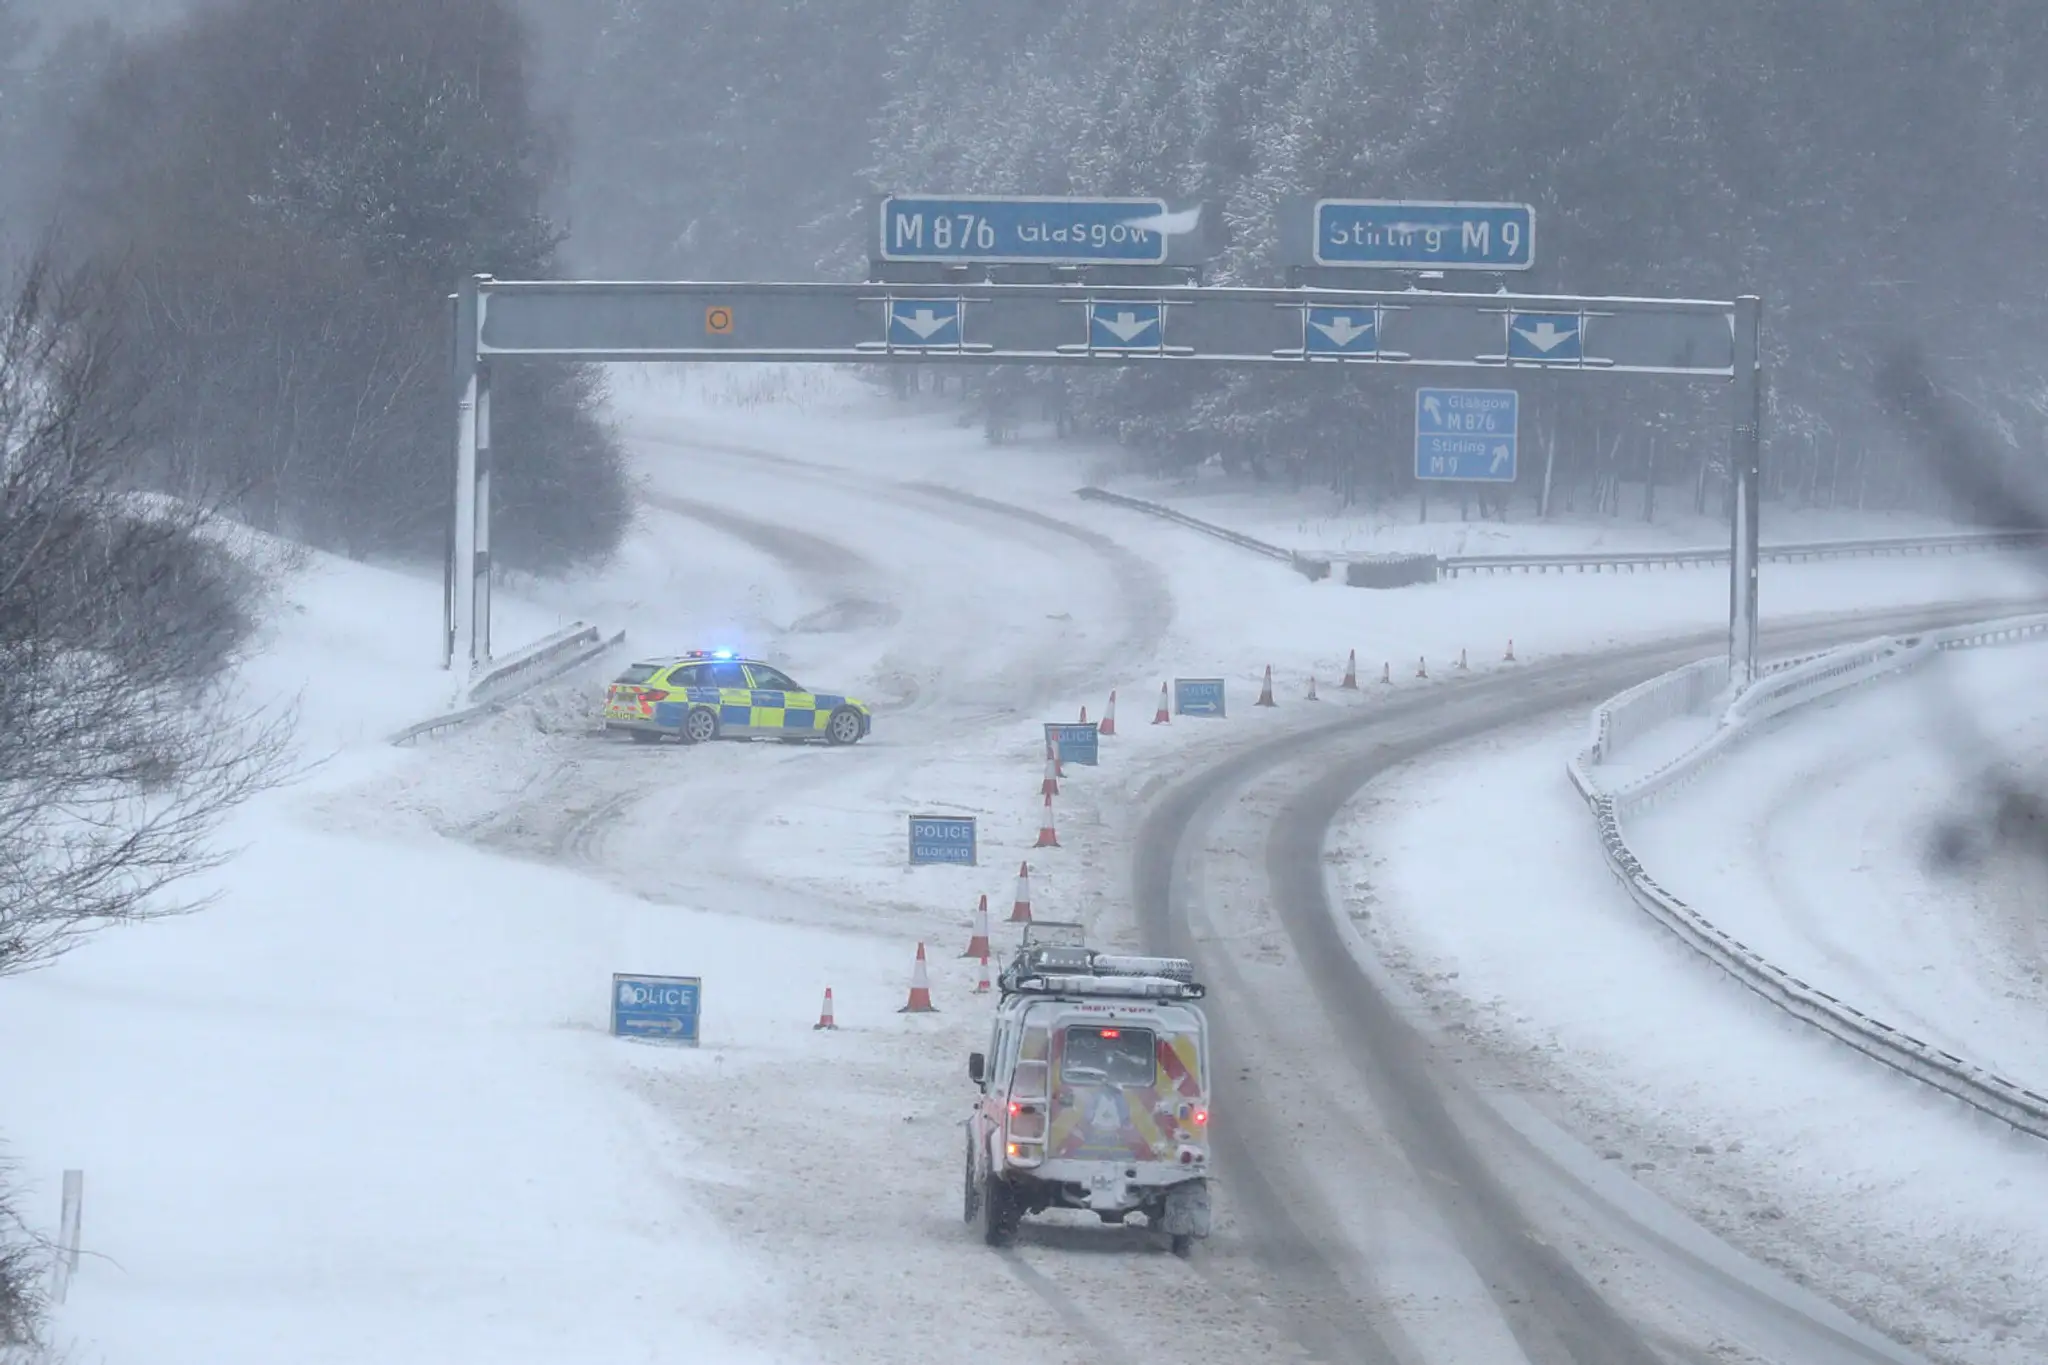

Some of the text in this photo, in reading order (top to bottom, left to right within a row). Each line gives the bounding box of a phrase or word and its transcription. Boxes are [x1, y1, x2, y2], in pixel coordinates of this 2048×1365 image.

[1448, 395, 1511, 411] Glasgow
[1432, 438, 1486, 455] Stirling
[914, 824, 970, 838] POLICE
